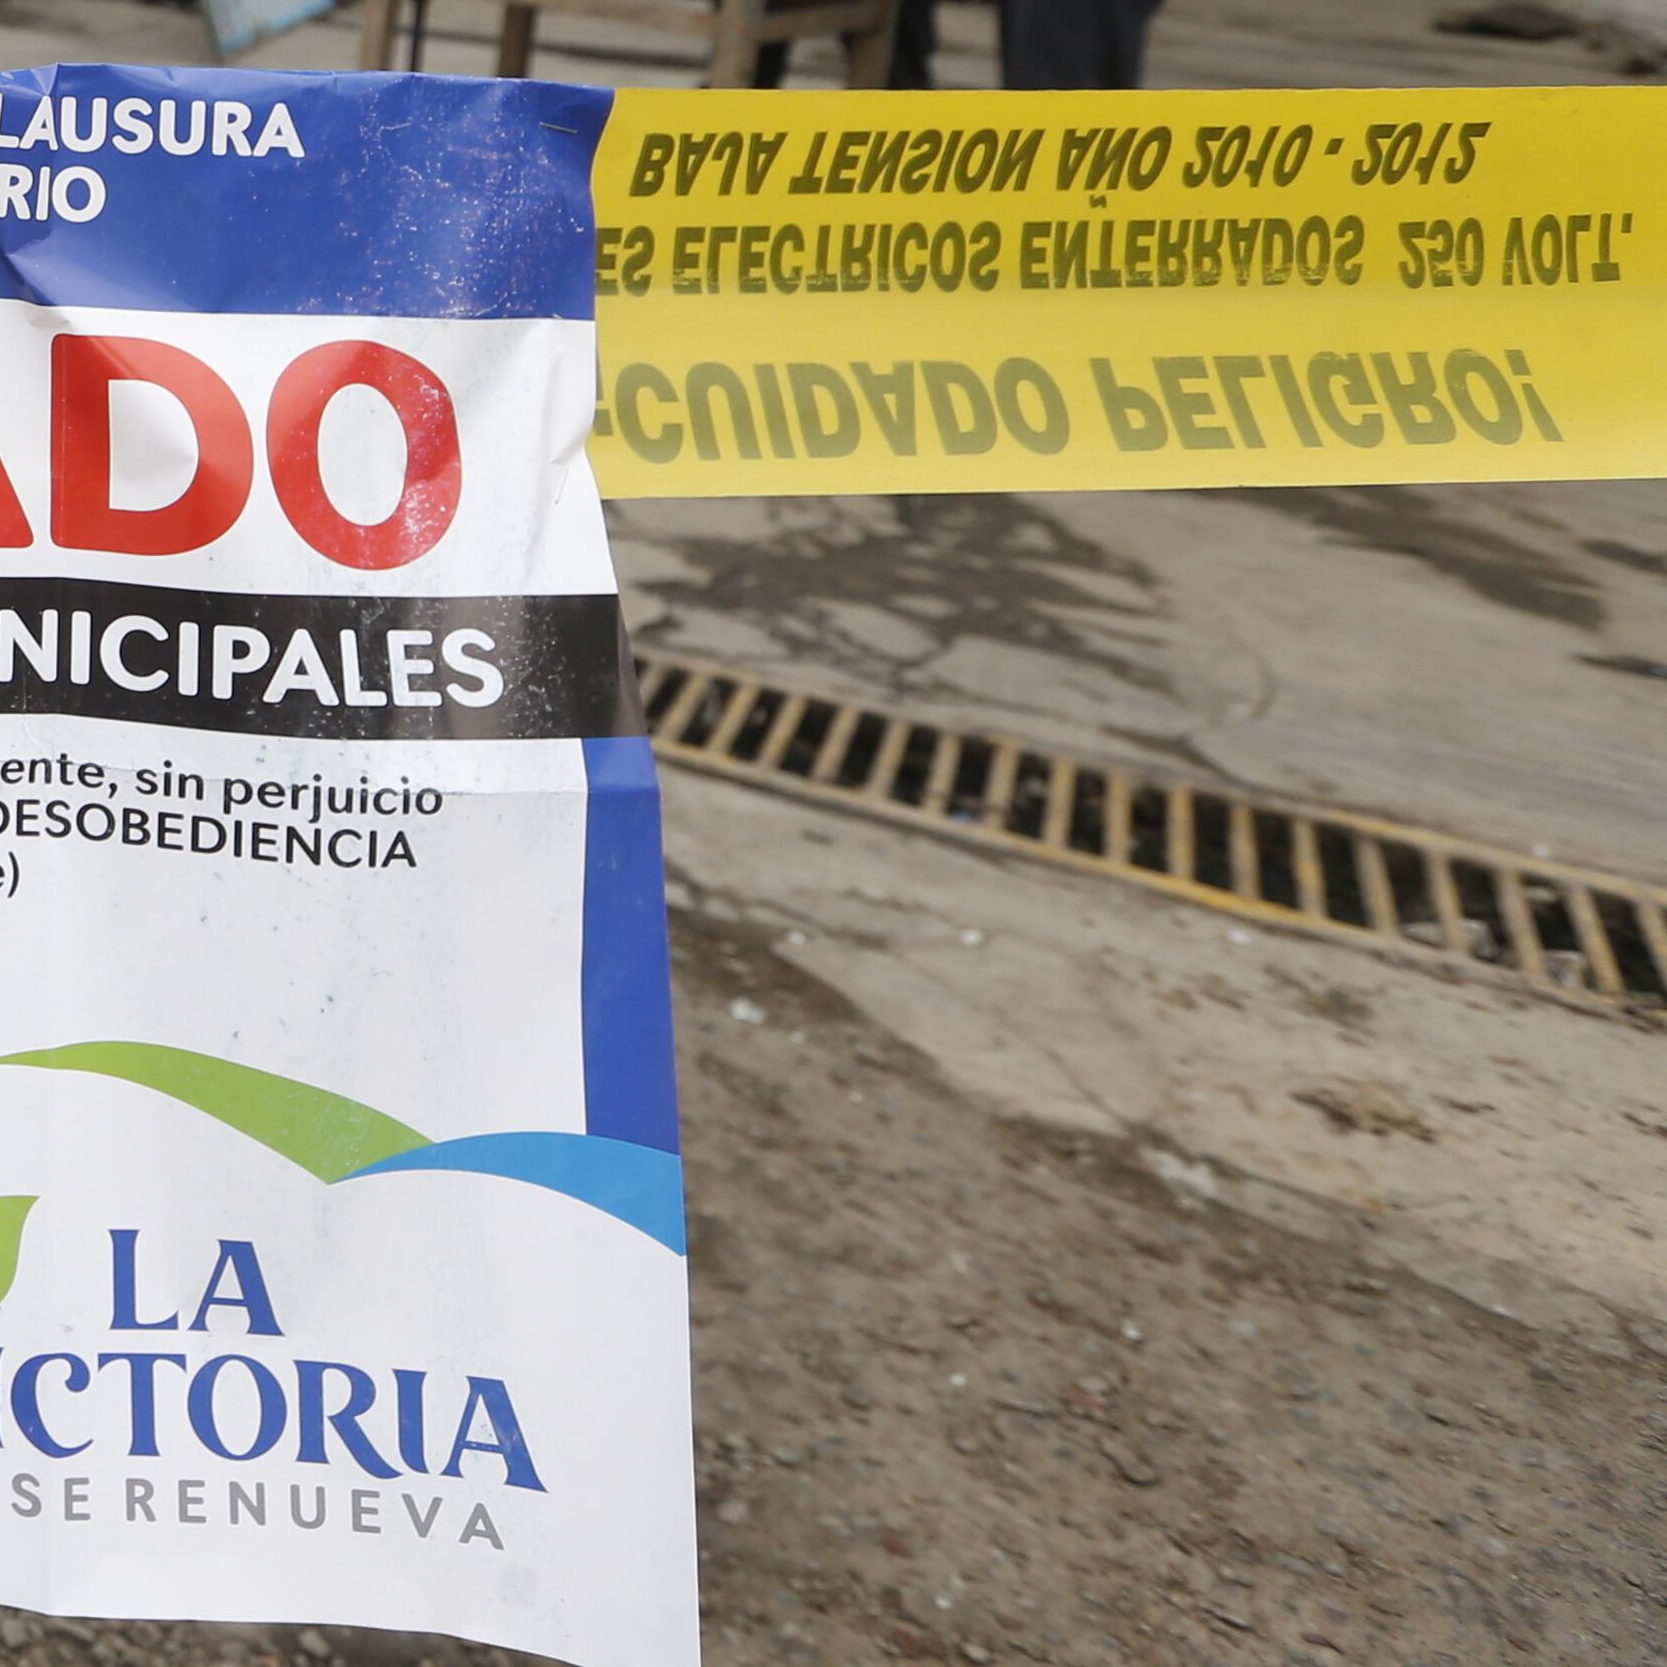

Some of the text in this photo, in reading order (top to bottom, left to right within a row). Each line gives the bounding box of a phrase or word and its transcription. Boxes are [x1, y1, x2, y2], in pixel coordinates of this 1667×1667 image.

[135, 761, 205, 801] sin
[223, 775, 444, 824] perjuicio
[107, 1228, 287, 1337] LA
